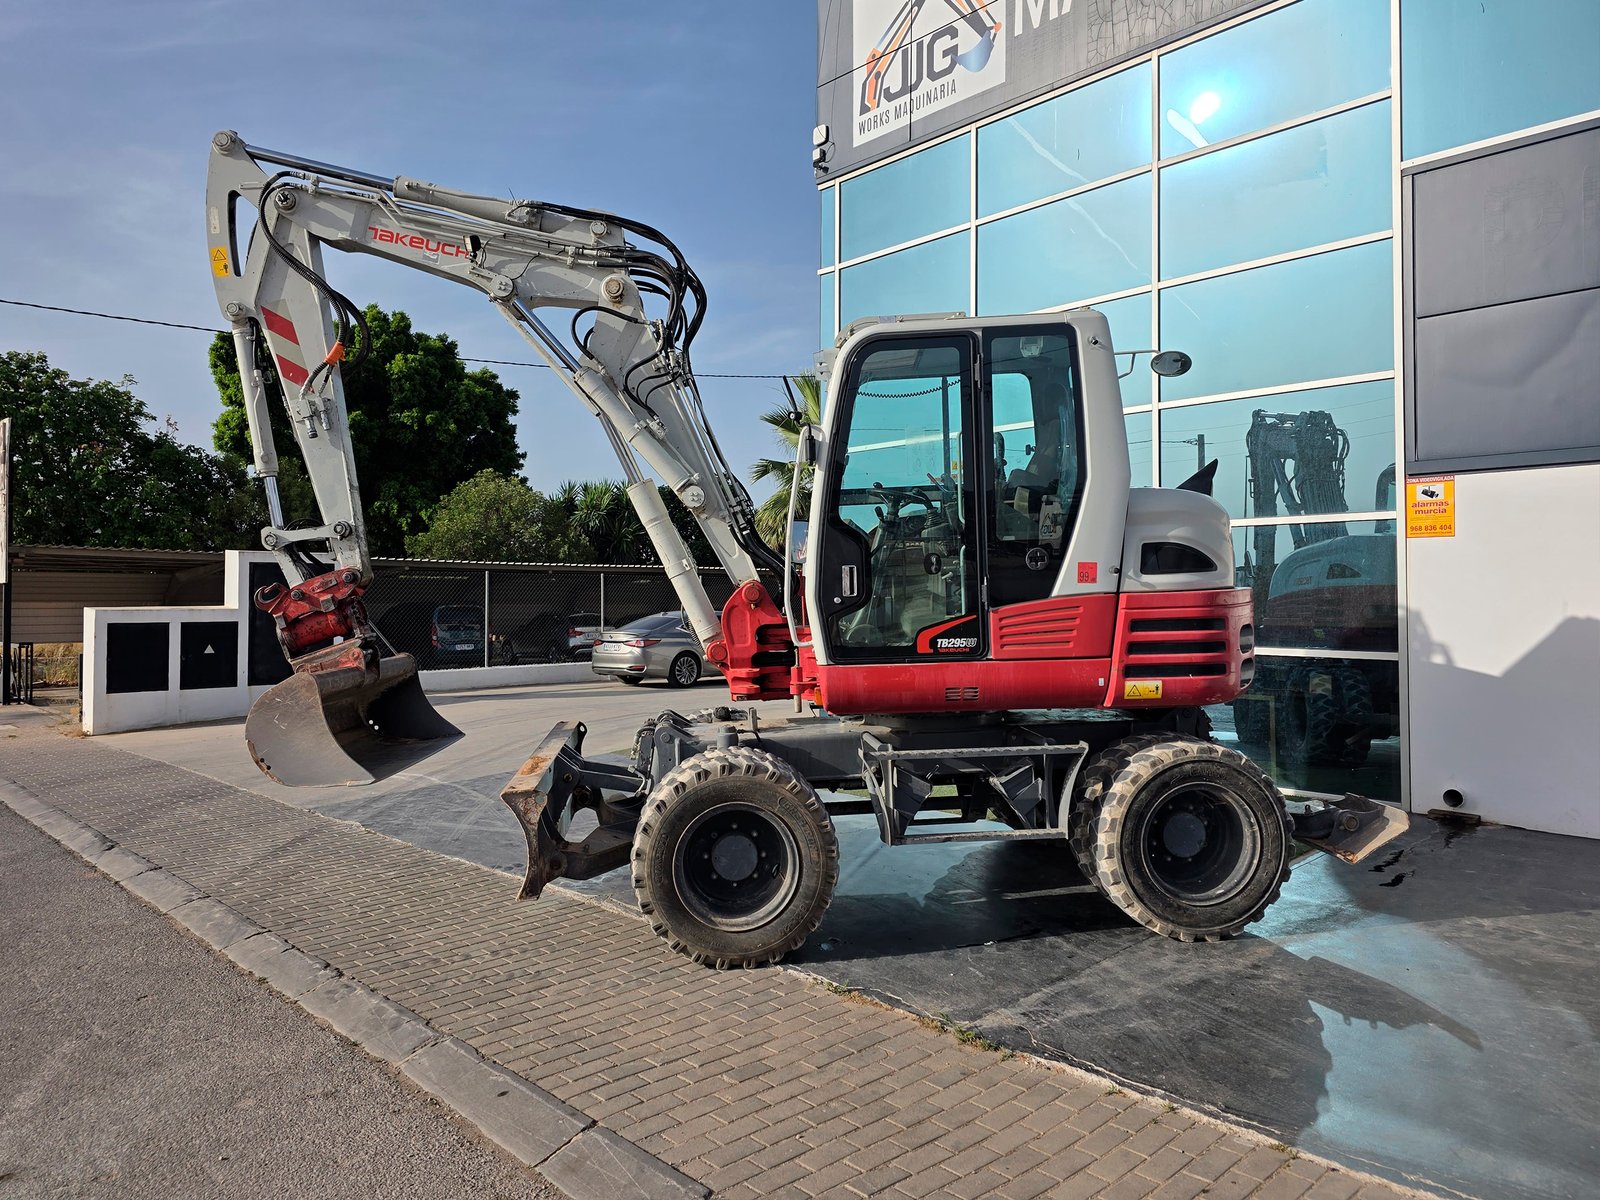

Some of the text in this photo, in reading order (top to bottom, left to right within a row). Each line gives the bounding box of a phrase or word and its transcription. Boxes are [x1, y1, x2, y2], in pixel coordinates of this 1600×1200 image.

[858, 78, 957, 136] WORKS MAQUINARIA
[1411, 500, 1450, 508] alarmas
